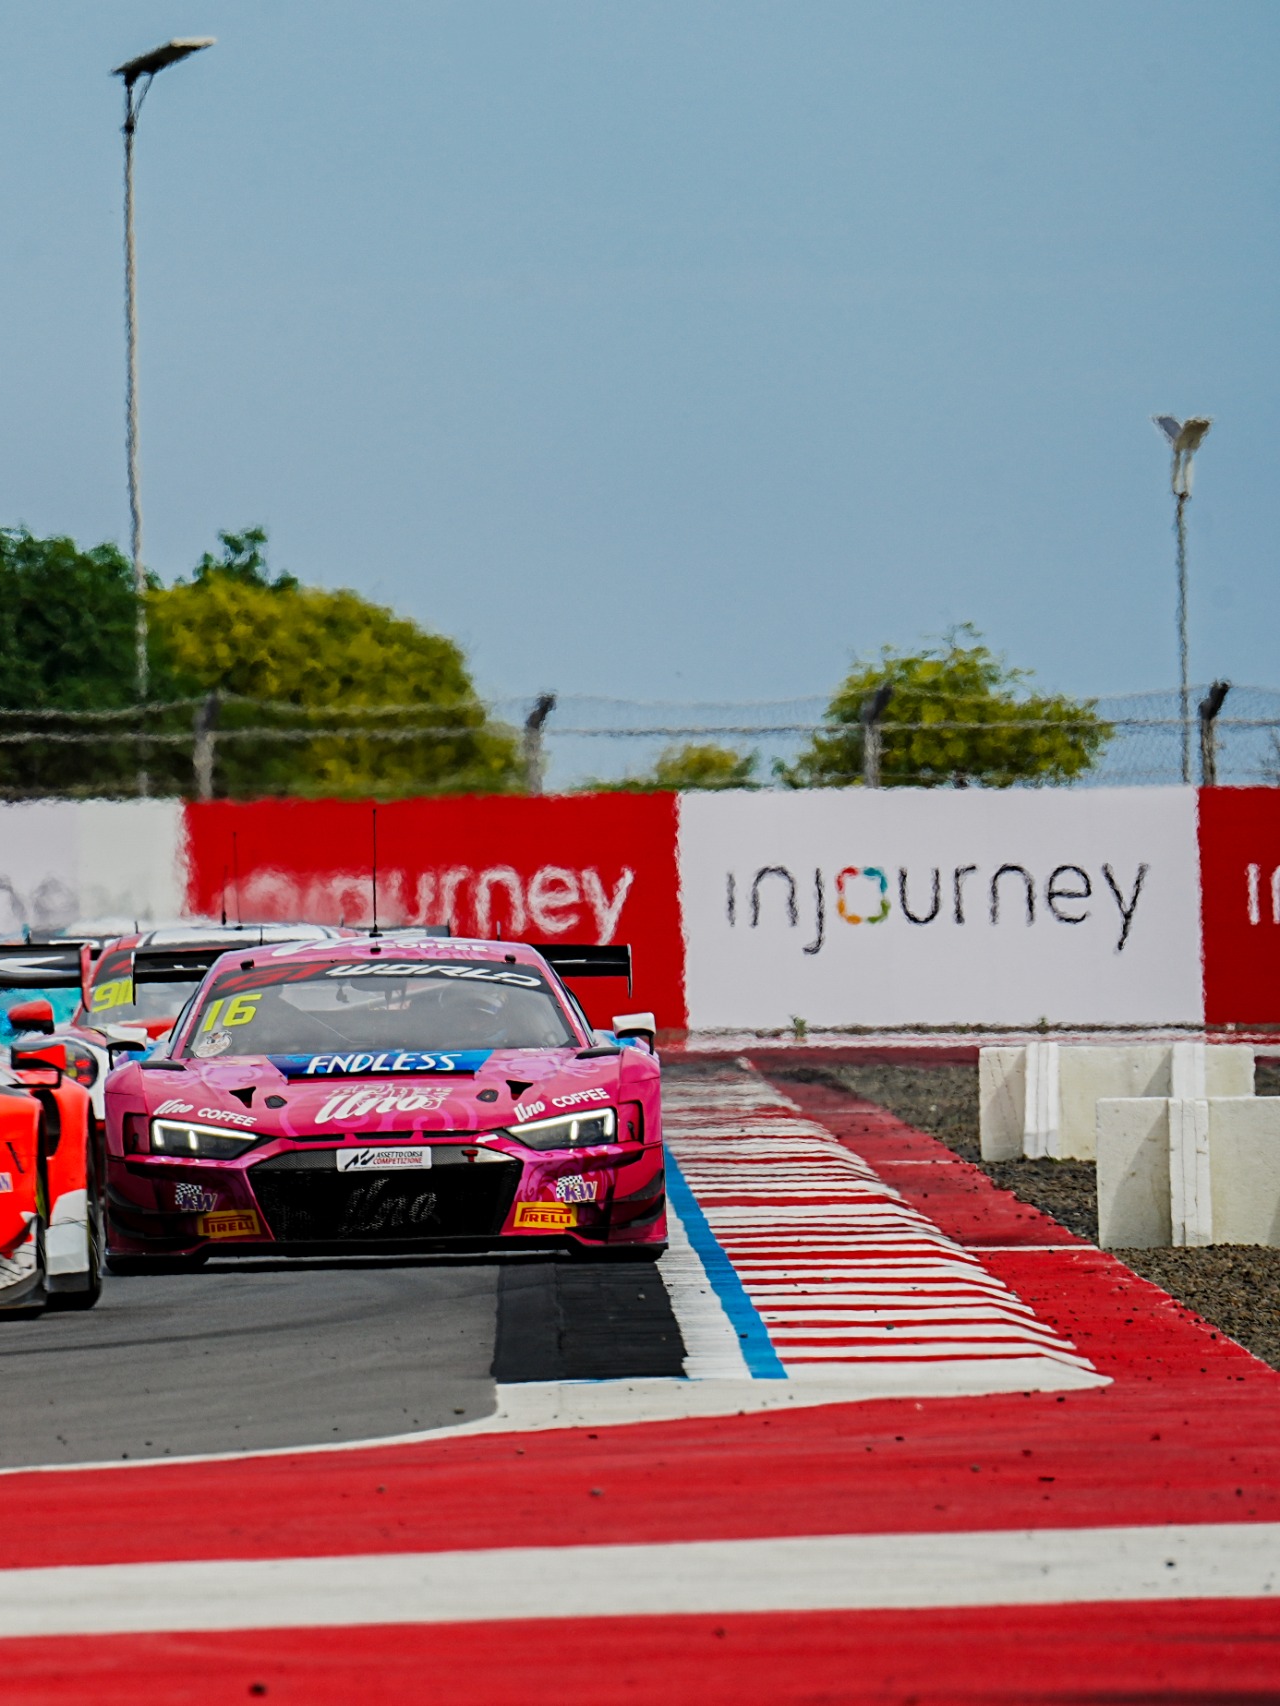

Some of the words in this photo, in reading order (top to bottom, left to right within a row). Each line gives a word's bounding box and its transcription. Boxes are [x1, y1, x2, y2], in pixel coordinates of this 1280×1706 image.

[724, 863, 1150, 954] injourney
[216, 959, 365, 992] GT
[325, 964, 542, 987] WORLD
[201, 993, 262, 1032] 16
[306, 1053, 463, 1075] ENDLESS
[551, 1087, 611, 1108] COFFEE
[197, 1107, 258, 1127] COFFEE
[564, 1181, 598, 1203] KW
[202, 1214, 255, 1234] PIRELLI
[518, 1206, 572, 1224] PIRELLI
